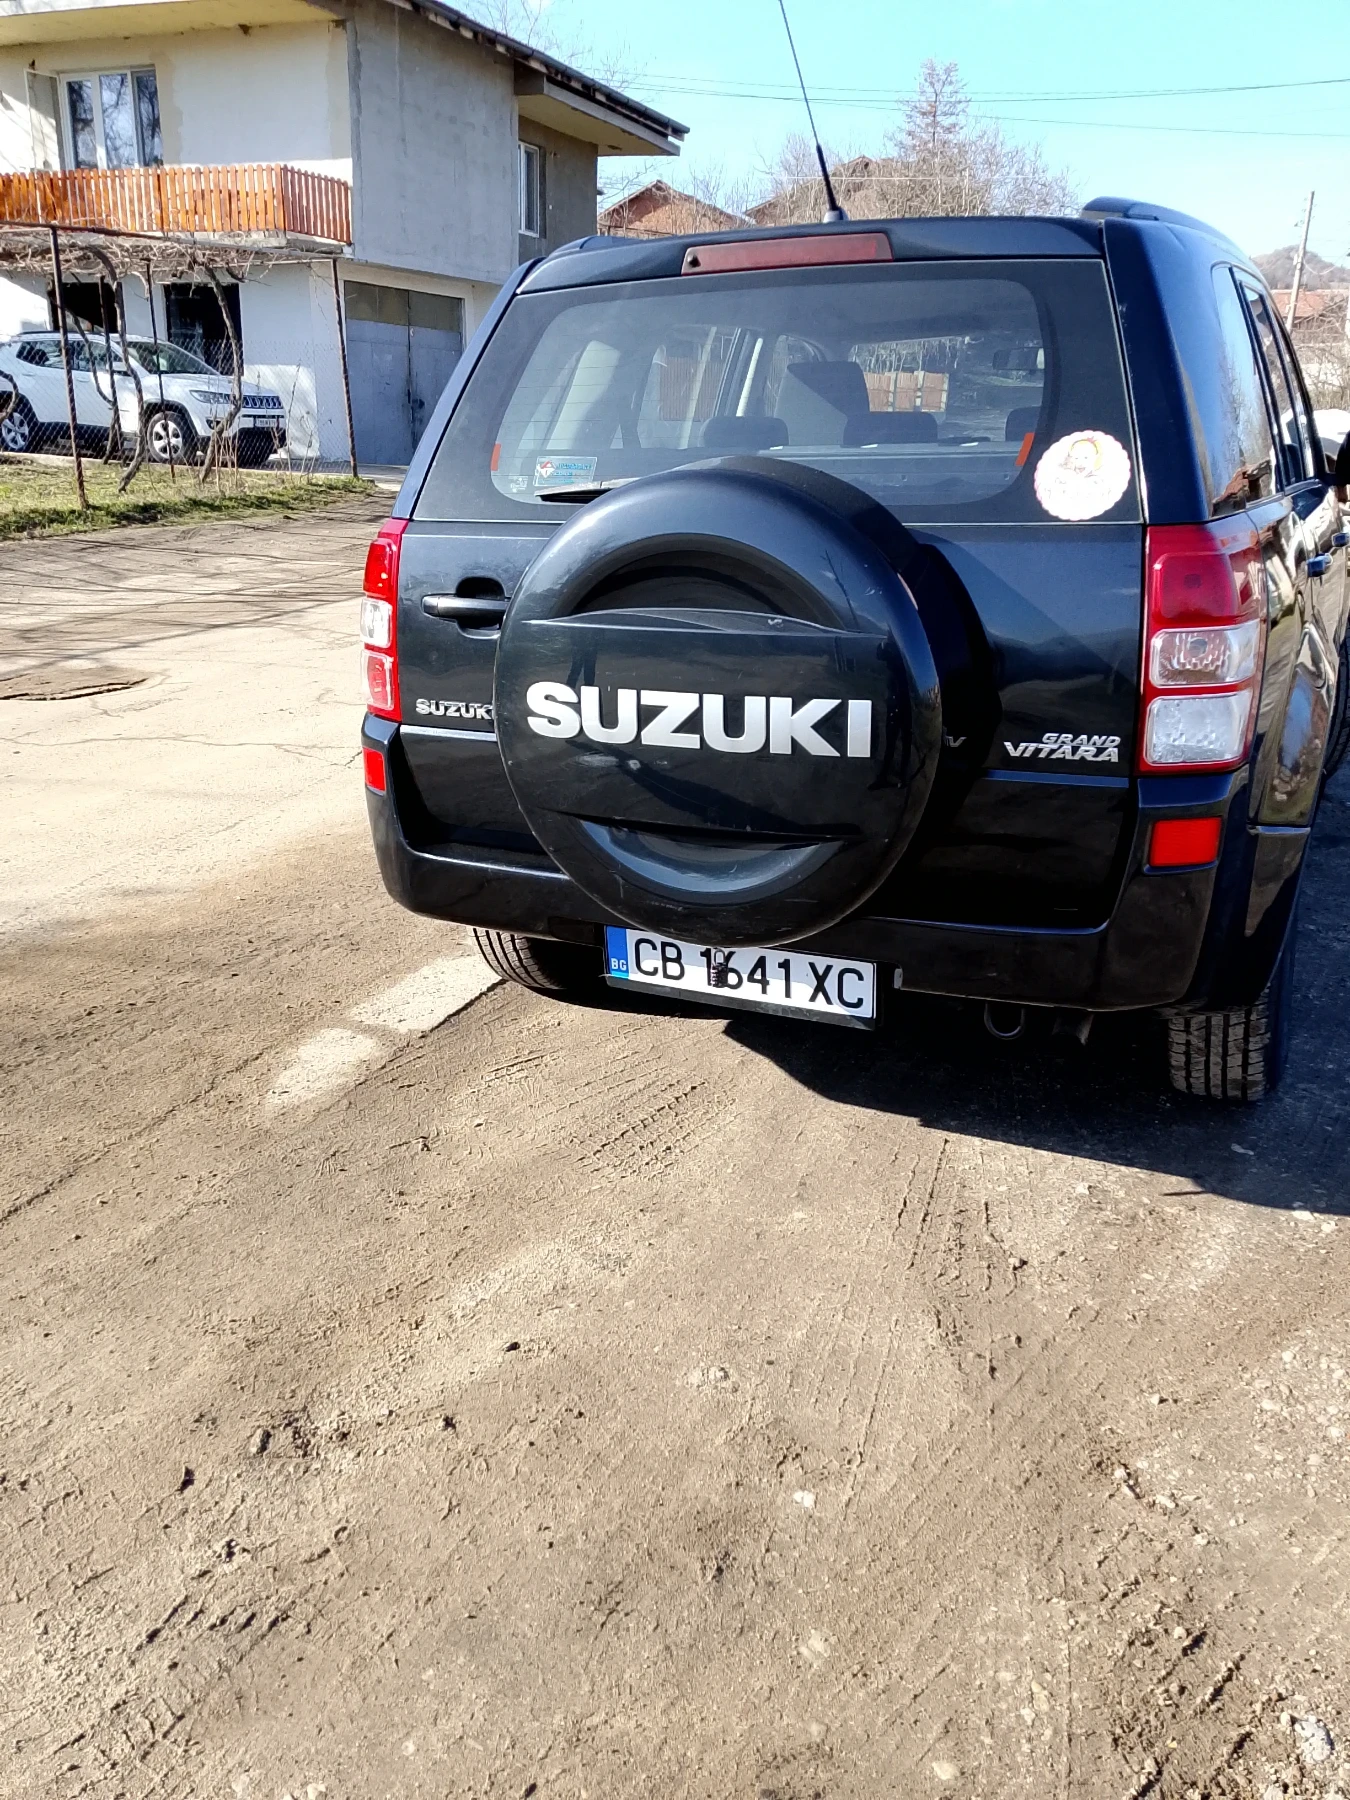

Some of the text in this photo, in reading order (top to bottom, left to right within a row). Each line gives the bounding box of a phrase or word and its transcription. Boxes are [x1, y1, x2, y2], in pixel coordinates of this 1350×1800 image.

[526, 681, 872, 758] SUZUKI
[1041, 732, 1121, 747] GRAND
[1003, 741, 1119, 762] VITARA
[610, 958, 627, 970] BG
[634, 938, 685, 980] CB
[808, 961, 865, 1009] XC
